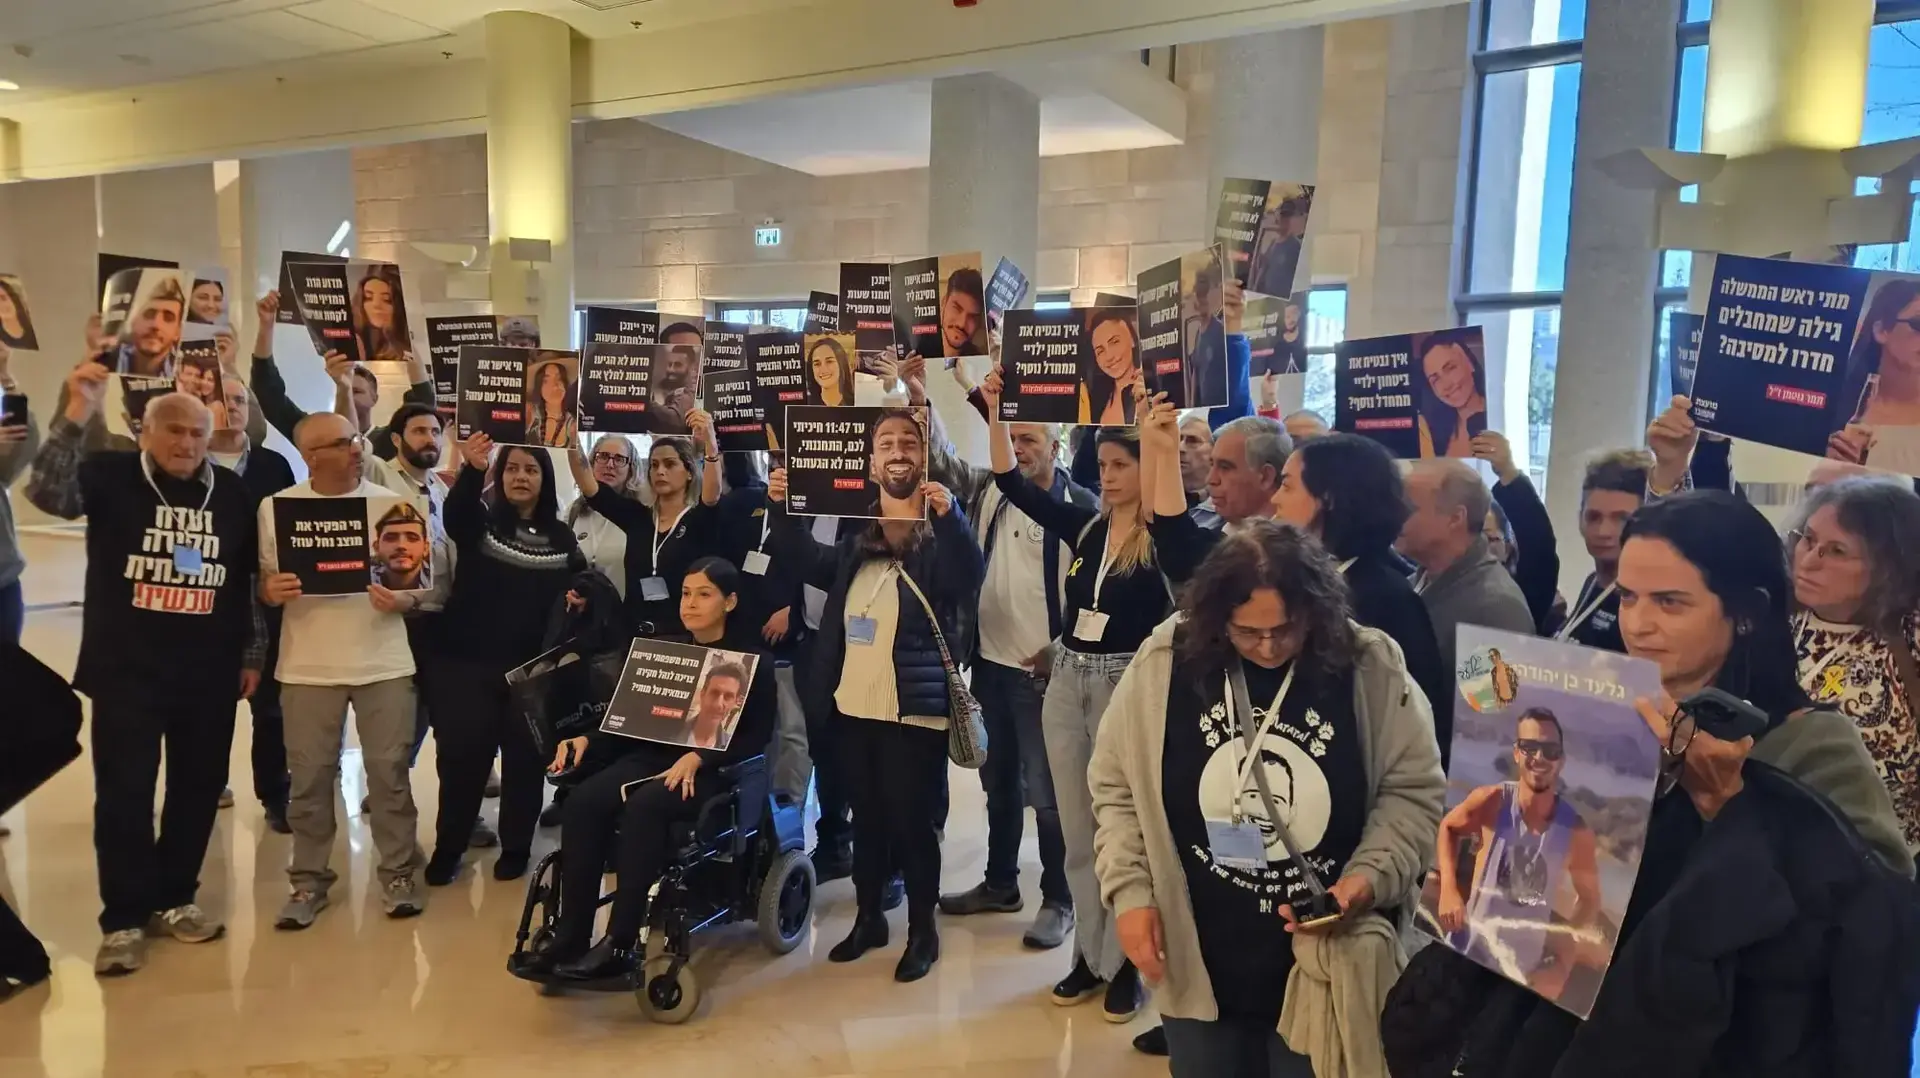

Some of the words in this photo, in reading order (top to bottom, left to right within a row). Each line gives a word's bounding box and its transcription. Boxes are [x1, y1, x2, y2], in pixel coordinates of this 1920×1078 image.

[904, 274, 920, 286] אישרו
[921, 270, 935, 284] למה
[847, 289, 870, 300] שעות
[916, 289, 936, 301] מסיבה
[1720, 277, 1778, 302] הממשלה
[906, 290, 915, 302] ליד
[1780, 288, 1814, 306] ראש
[1818, 291, 1850, 310] מתי
[846, 303, 875, 315] מספרי?
[914, 305, 936, 318] הגבול?
[1718, 304, 1796, 334] שמחבלים
[619, 320, 640, 332] ייתכן
[641, 322, 656, 334] איך
[1019, 324, 1034, 337] את
[1034, 324, 1062, 337] נבטיח
[1063, 324, 1080, 338] איך
[1798, 316, 1842, 342] גילה
[594, 333, 619, 343] שעות
[758, 344, 782, 356] שלושת
[784, 342, 800, 356] למה
[1023, 342, 1046, 356] ילדיי
[1046, 343, 1078, 358] ביטחון
[1719, 334, 1788, 365] למסיבה?
[477, 360, 490, 370] את
[594, 354, 616, 365] הגיעו
[617, 354, 629, 366] לא
[630, 356, 650, 366] מדוע
[784, 358, 801, 370] בלוני
[1348, 356, 1362, 370] את
[1363, 354, 1390, 368] נבטיח
[1391, 352, 1408, 369] איך
[1791, 349, 1835, 374] חדרו
[490, 360, 512, 372] אישר
[513, 361, 523, 372] מי
[756, 360, 783, 372] התצפית
[1016, 362, 1042, 376] נוסף?
[1044, 361, 1076, 374] ממחדל
[478, 374, 490, 386] על
[588, 370, 602, 380] את
[604, 368, 624, 382] לחלץ
[625, 371, 648, 381] כוחות
[756, 374, 789, 387] מושבתים?
[790, 374, 802, 385] היו
[490, 376, 522, 388] המסיבה
[1354, 374, 1376, 390] ילדיי
[1377, 373, 1410, 390] ביטחון
[598, 384, 627, 396] הנובה?
[628, 385, 646, 396] מבלי
[714, 384, 725, 392] את
[465, 390, 483, 401] עזה?
[484, 392, 496, 402] עם
[497, 392, 522, 404] הגבול
[735, 394, 752, 406] טחון
[1375, 394, 1411, 408] ממחדל
[1783, 389, 1805, 402] גוטמן
[1807, 394, 1824, 406] תמר
[1348, 396, 1375, 412] נוסף?
[734, 408, 754, 418] מחדל
[793, 421, 824, 433] חיכיתי
[825, 422, 852, 434] 11:47
[853, 422, 865, 433] עד
[798, 440, 843, 453] התחננתי,
[844, 438, 864, 454] לכם,
[790, 456, 829, 470] הגעתם?
[830, 456, 844, 470] לא
[844, 458, 864, 470] למה
[155, 505, 213, 534] ועדת
[350, 520, 362, 531] מי
[296, 520, 312, 532] את
[314, 520, 348, 533] הפקיר
[142, 528, 220, 560] חקירה
[290, 536, 314, 548] עוז?
[316, 535, 336, 548] נחל
[337, 536, 363, 548] מוצב
[134, 583, 215, 613] עכשיו!
[652, 652, 681, 666] משפחתי
[680, 656, 700, 668] מדוע
[636, 666, 658, 679] חקירה
[658, 668, 675, 682] לנהל
[675, 672, 696, 684] צריכה
[1517, 663, 1558, 684] יהודה
[1564, 672, 1578, 690] בן
[631, 682, 651, 694] מותי?
[652, 684, 662, 695] על
[661, 686, 690, 700] עצמאית
[1584, 677, 1625, 700] גלעד
[1266, 884, 1282, 894] OF
